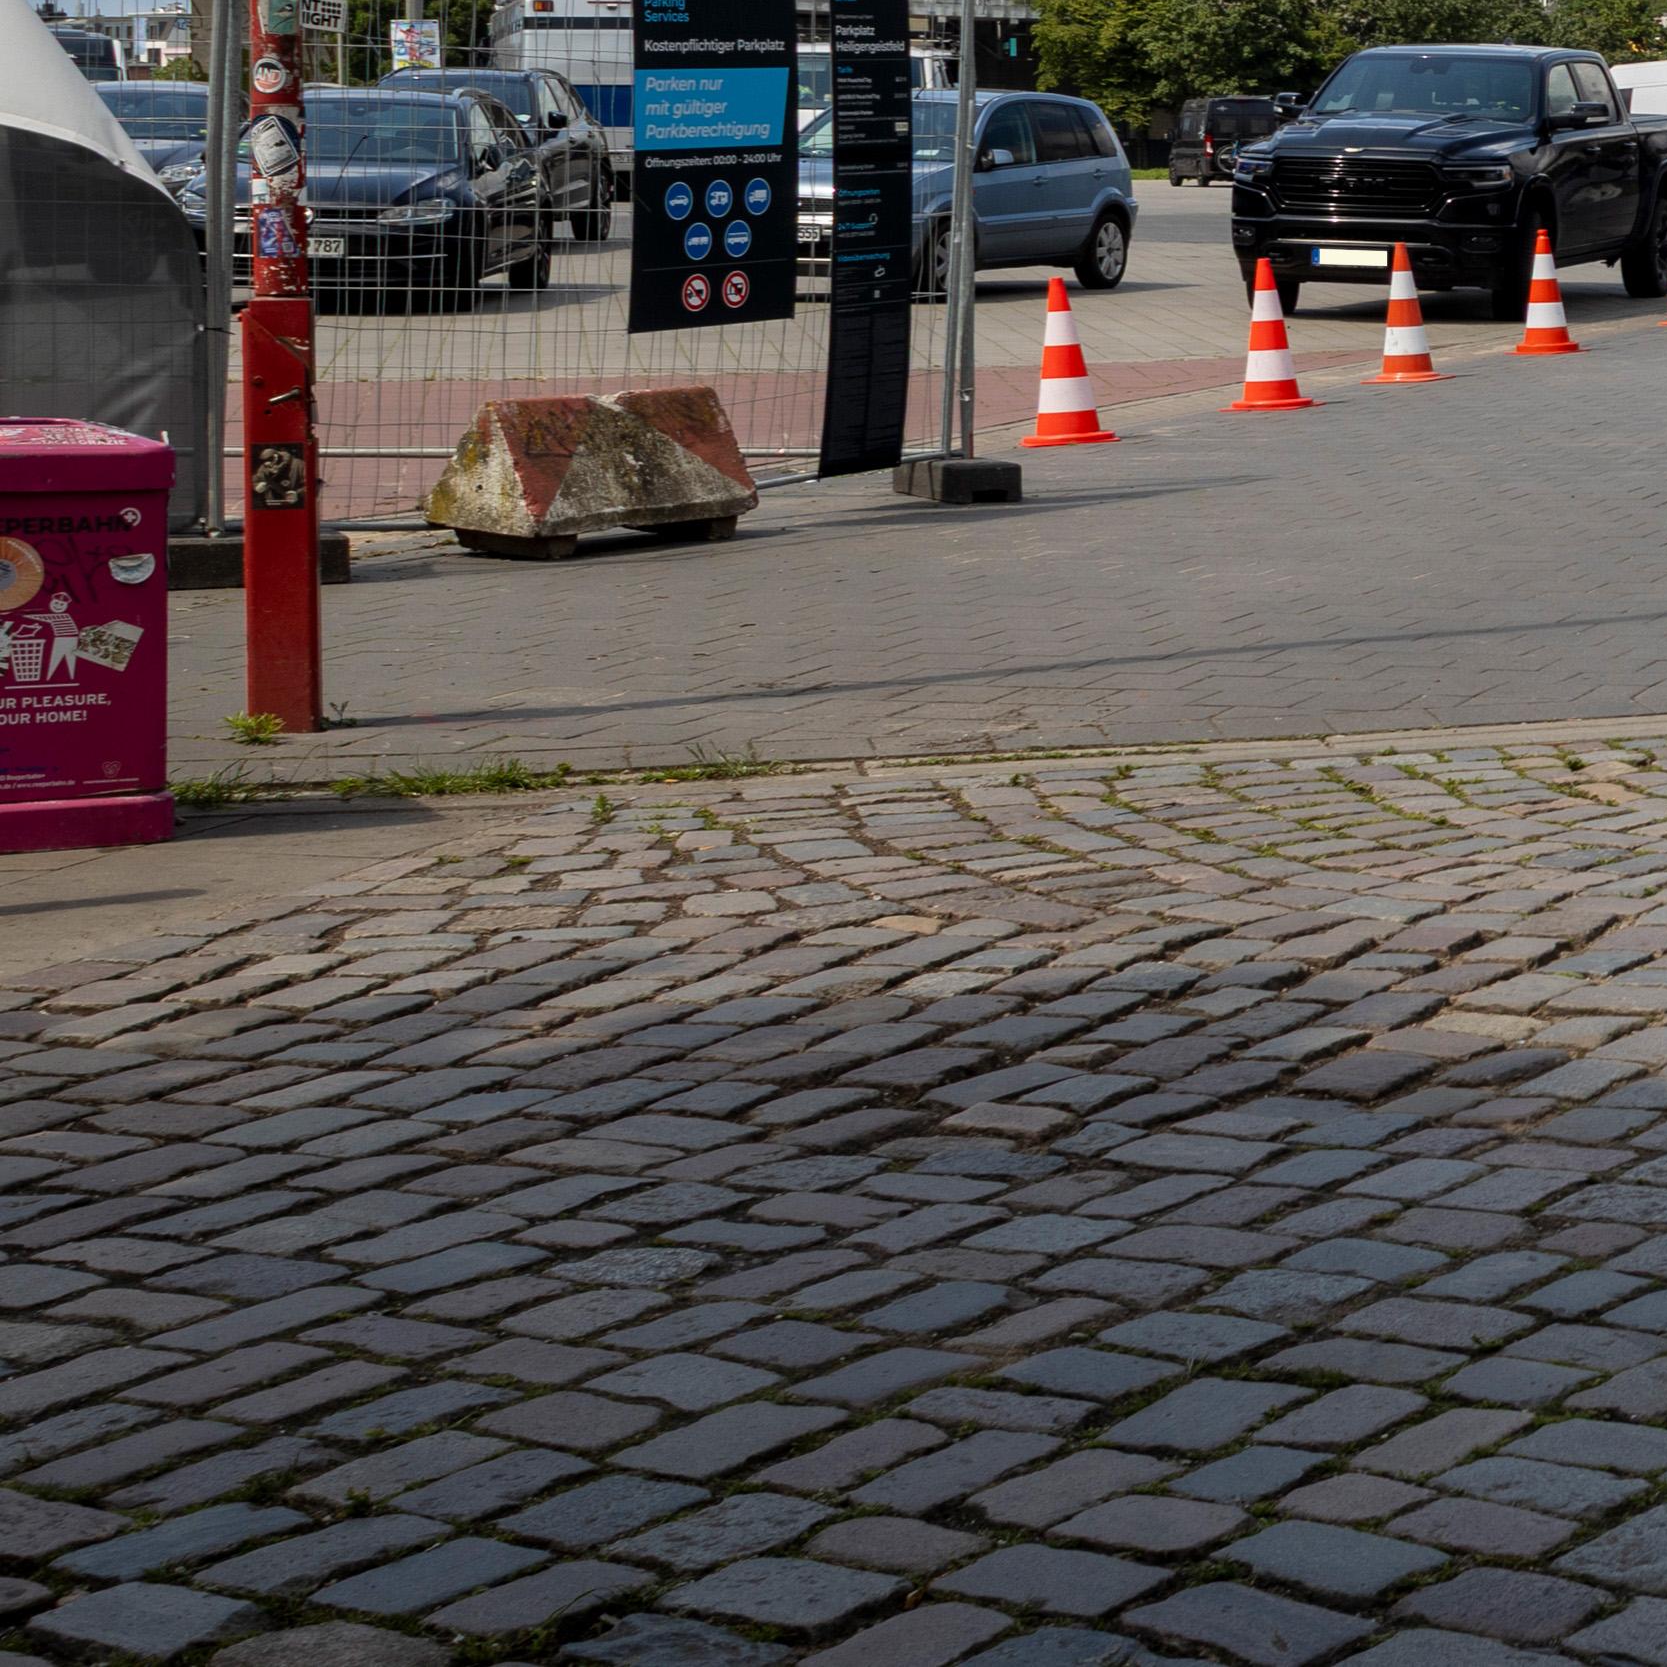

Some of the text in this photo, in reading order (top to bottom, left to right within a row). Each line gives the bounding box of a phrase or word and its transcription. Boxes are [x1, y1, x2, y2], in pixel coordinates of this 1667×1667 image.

[644, 10, 689, 22] Services
[835, 25, 875, 38] Parkplatz
[644, 39, 785, 54] Kostenpflichtiger Parkplatz
[836, 40, 905, 54] Heiligengeistfeld
[645, 77, 723, 92] Parken nur
[645, 100, 727, 118] mit gültiger
[645, 122, 770, 139] Parkberechtigung
[645, 156, 712, 169] Öffnungszeiten:
[713, 155, 737, 165] 00:00
[743, 154, 765, 164] 24:00
[767, 153, 782, 163] Uhr
[314, 240, 341, 253] 787
[0, 516, 133, 533] PERBAHN
[22, 693, 111, 707] PLEASURE,
[36, 710, 88, 723] HOME!
